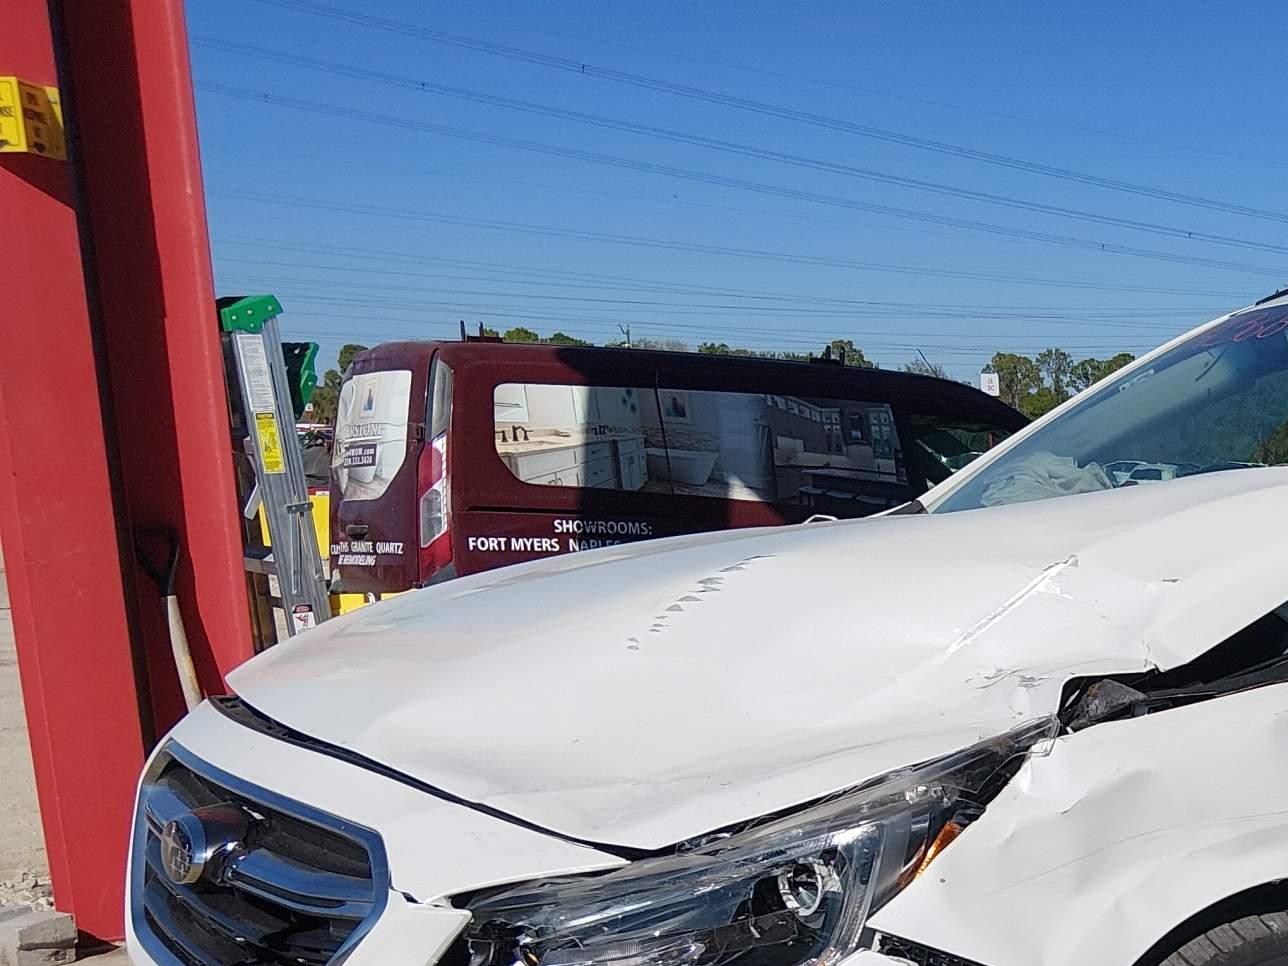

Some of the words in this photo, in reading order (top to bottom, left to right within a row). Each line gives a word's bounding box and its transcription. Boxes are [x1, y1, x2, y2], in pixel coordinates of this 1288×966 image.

[553, 519, 653, 535] SHOWROOMS:
[375, 542, 404, 555] QUARTZ
[468, 537, 507, 551] FORT
[510, 538, 560, 551] MYERS
